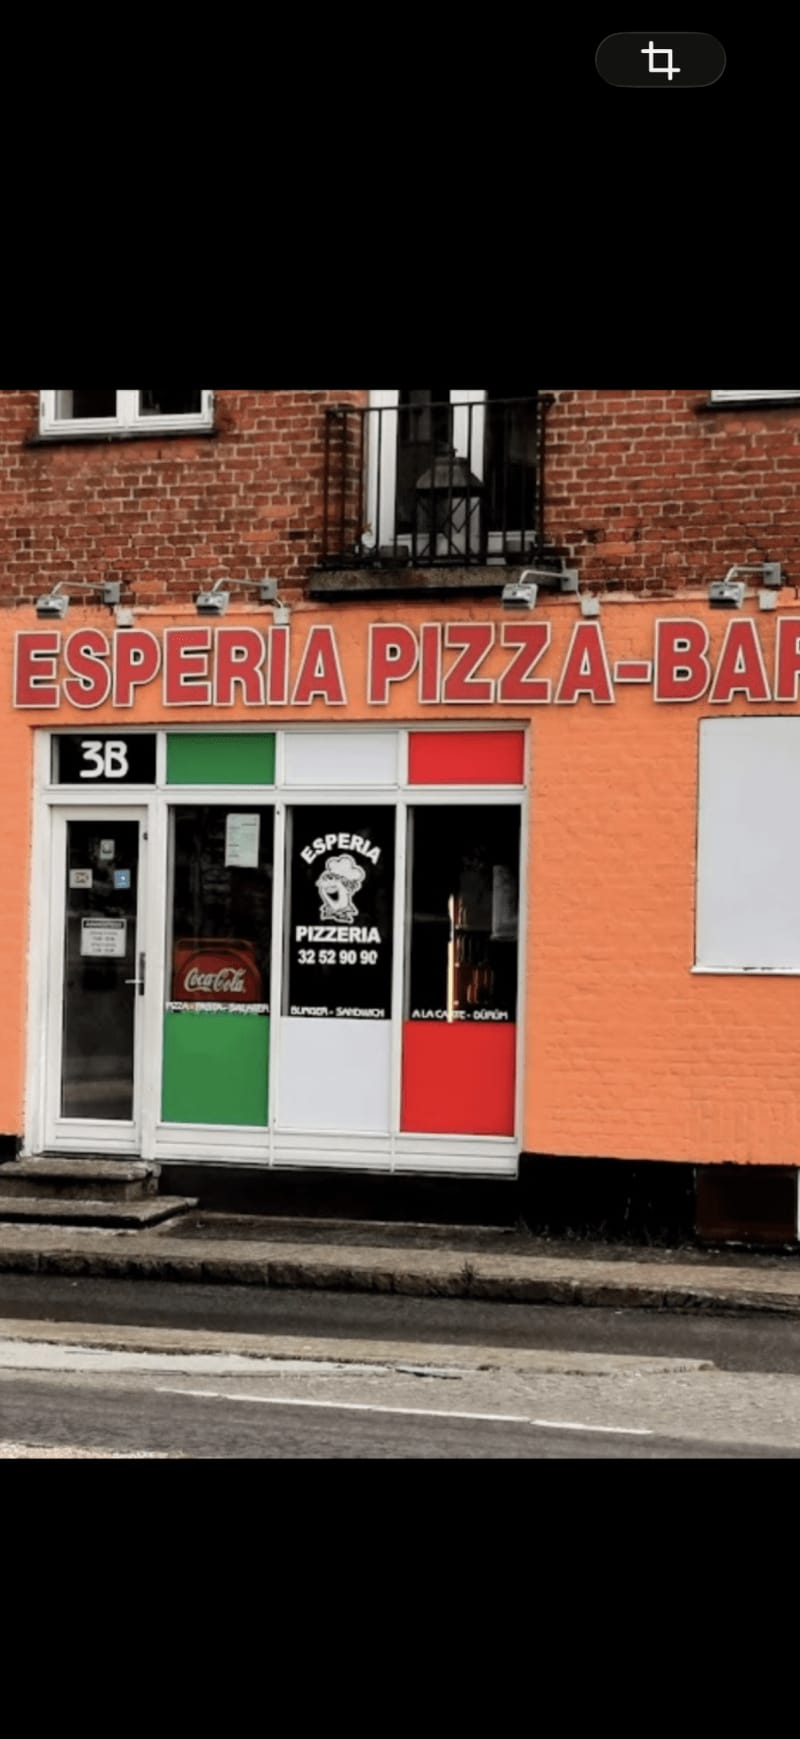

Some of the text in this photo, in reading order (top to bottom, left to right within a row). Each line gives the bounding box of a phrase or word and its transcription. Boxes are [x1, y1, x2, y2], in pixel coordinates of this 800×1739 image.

[13, 624, 347, 709] ESPERIA
[80, 740, 128, 778] 3B
[300, 832, 381, 865] ESPERIA
[296, 925, 381, 943] PIZZERIA
[297, 949, 378, 965] 32 52 90 90
[435, 1009, 466, 1019] CATE
